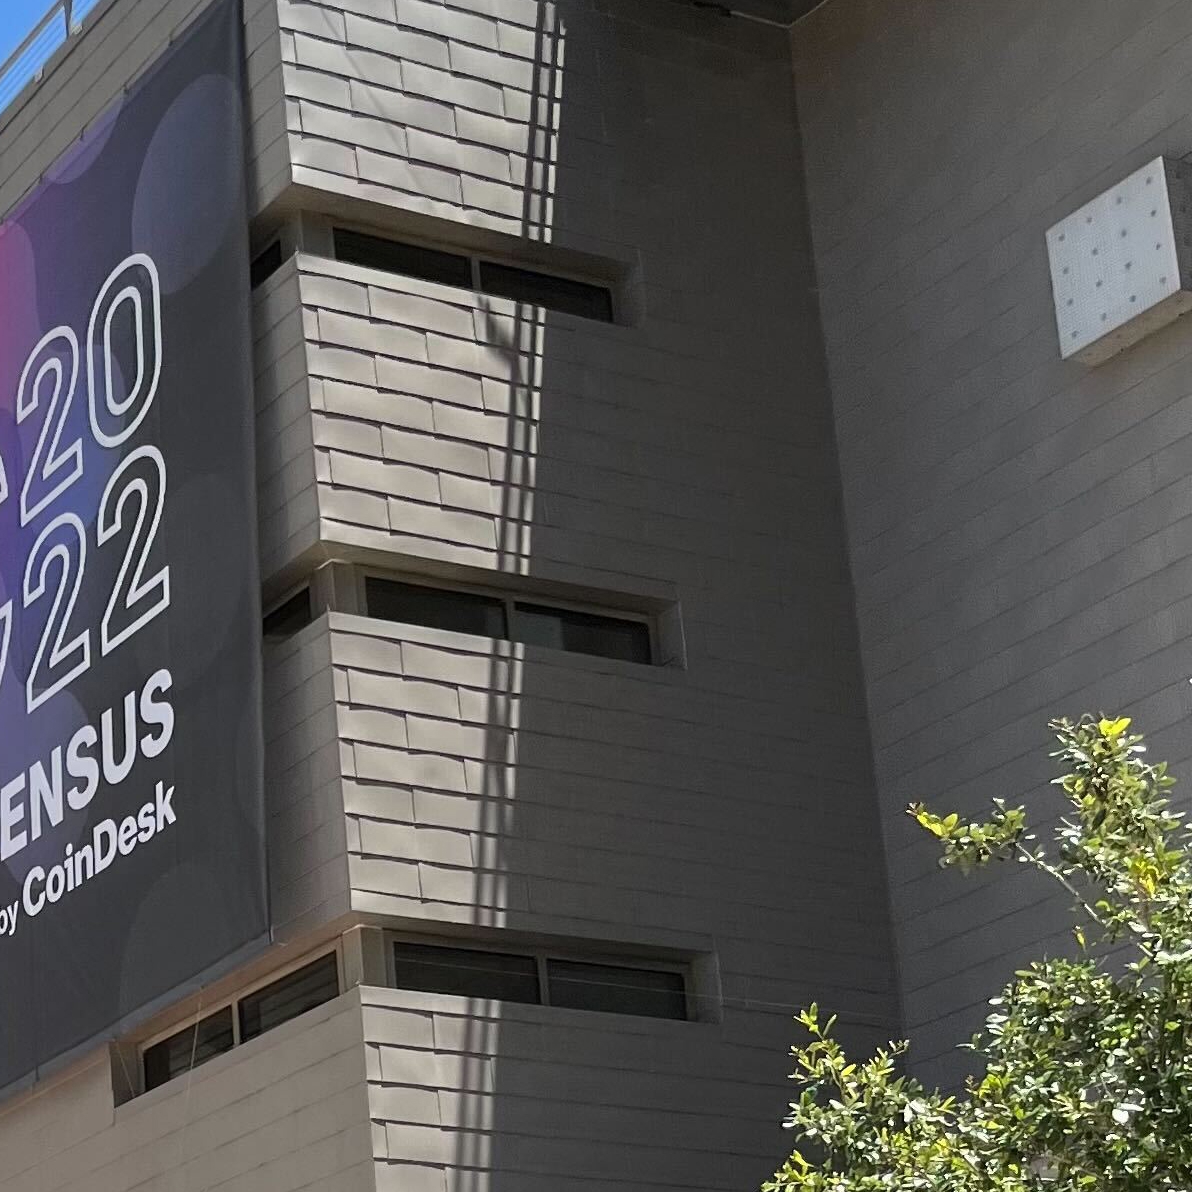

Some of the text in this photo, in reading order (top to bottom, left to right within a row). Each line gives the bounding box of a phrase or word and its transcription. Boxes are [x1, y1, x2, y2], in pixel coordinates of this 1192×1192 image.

[16, 252, 162, 528] 20
[22, 445, 170, 714] 22
[22, 781, 177, 918] CoinDesk
